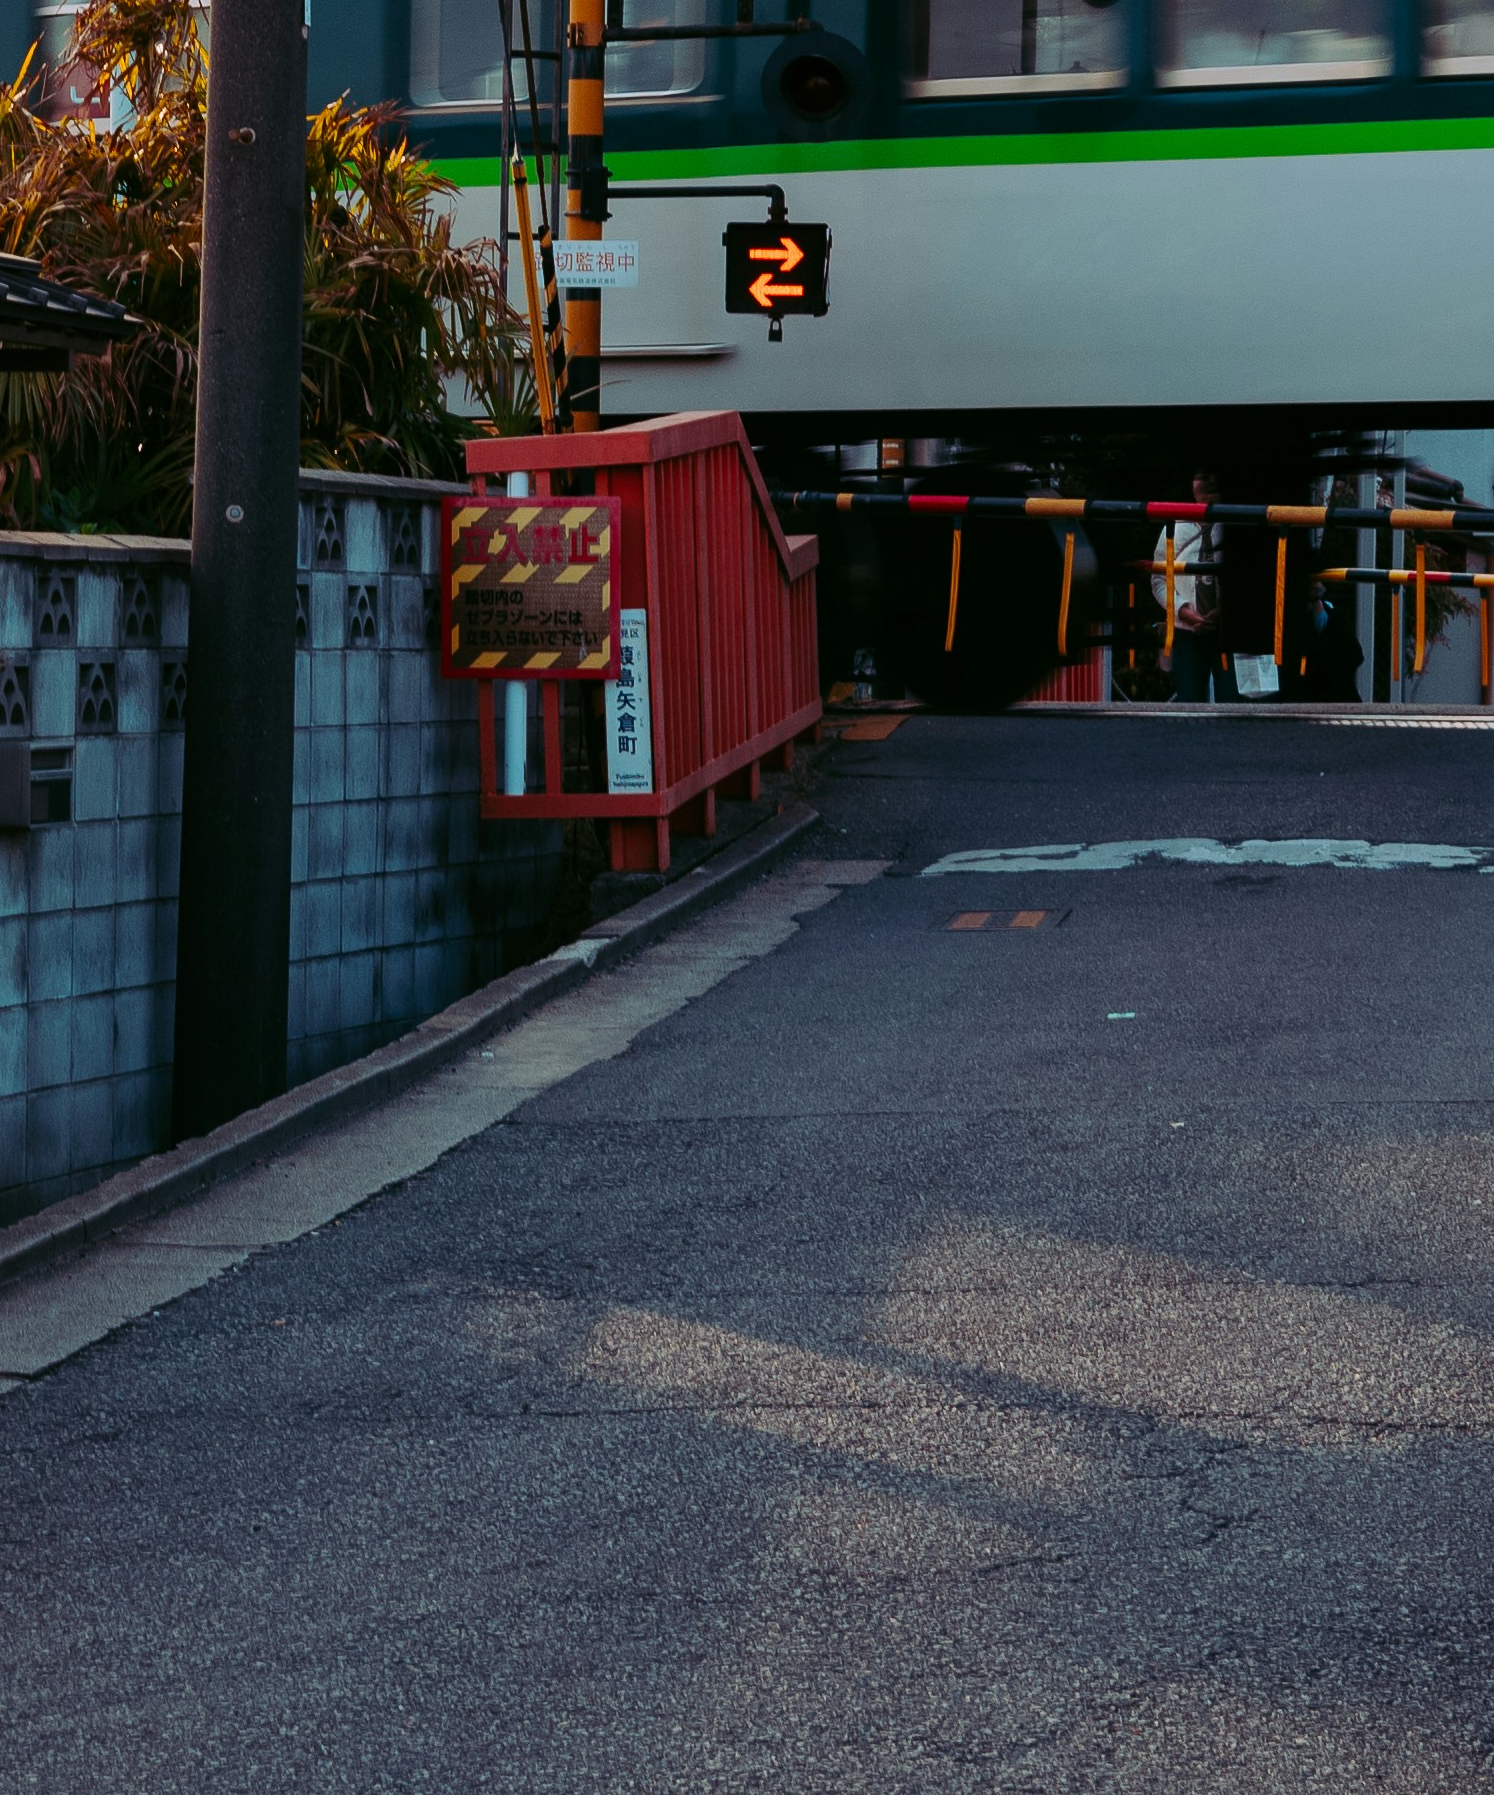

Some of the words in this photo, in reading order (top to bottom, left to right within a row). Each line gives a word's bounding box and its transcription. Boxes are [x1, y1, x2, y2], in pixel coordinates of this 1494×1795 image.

[463, 523, 600, 565] 立入禁止
[467, 610, 583, 626] ゼブラゾーンには
[465, 630, 598, 647] 立ち入らないで下さい
